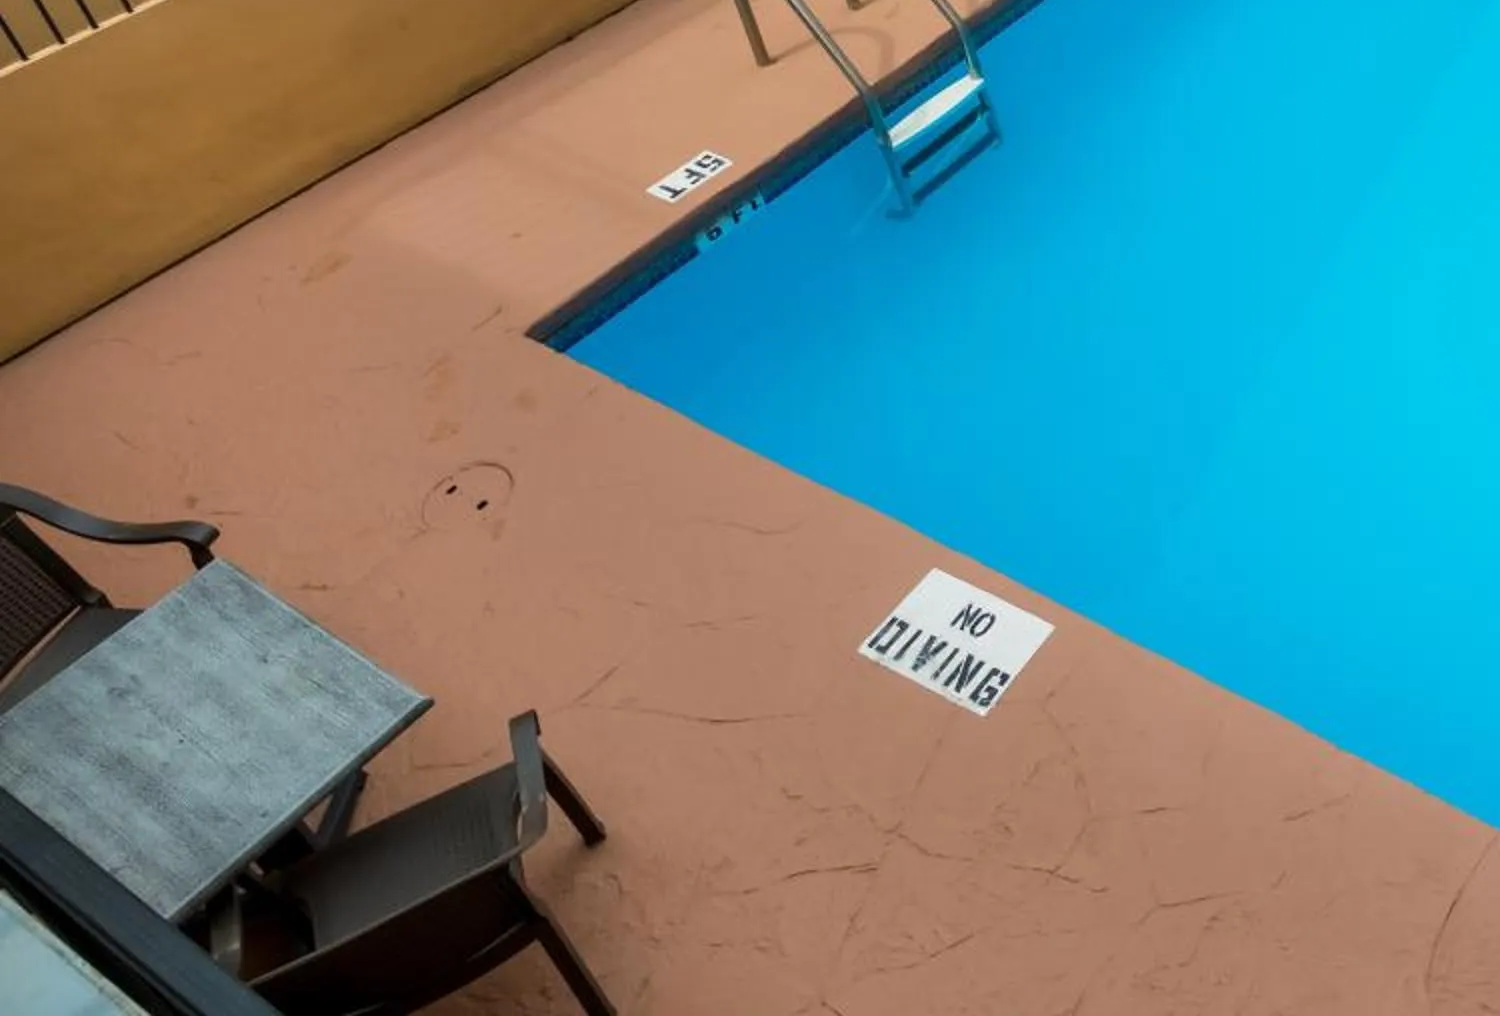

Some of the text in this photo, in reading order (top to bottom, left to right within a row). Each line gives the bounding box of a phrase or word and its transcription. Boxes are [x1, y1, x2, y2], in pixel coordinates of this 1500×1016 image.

[658, 154, 725, 199] 5FT
[949, 602, 997, 638] NO
[867, 615, 1011, 708] DIVING
